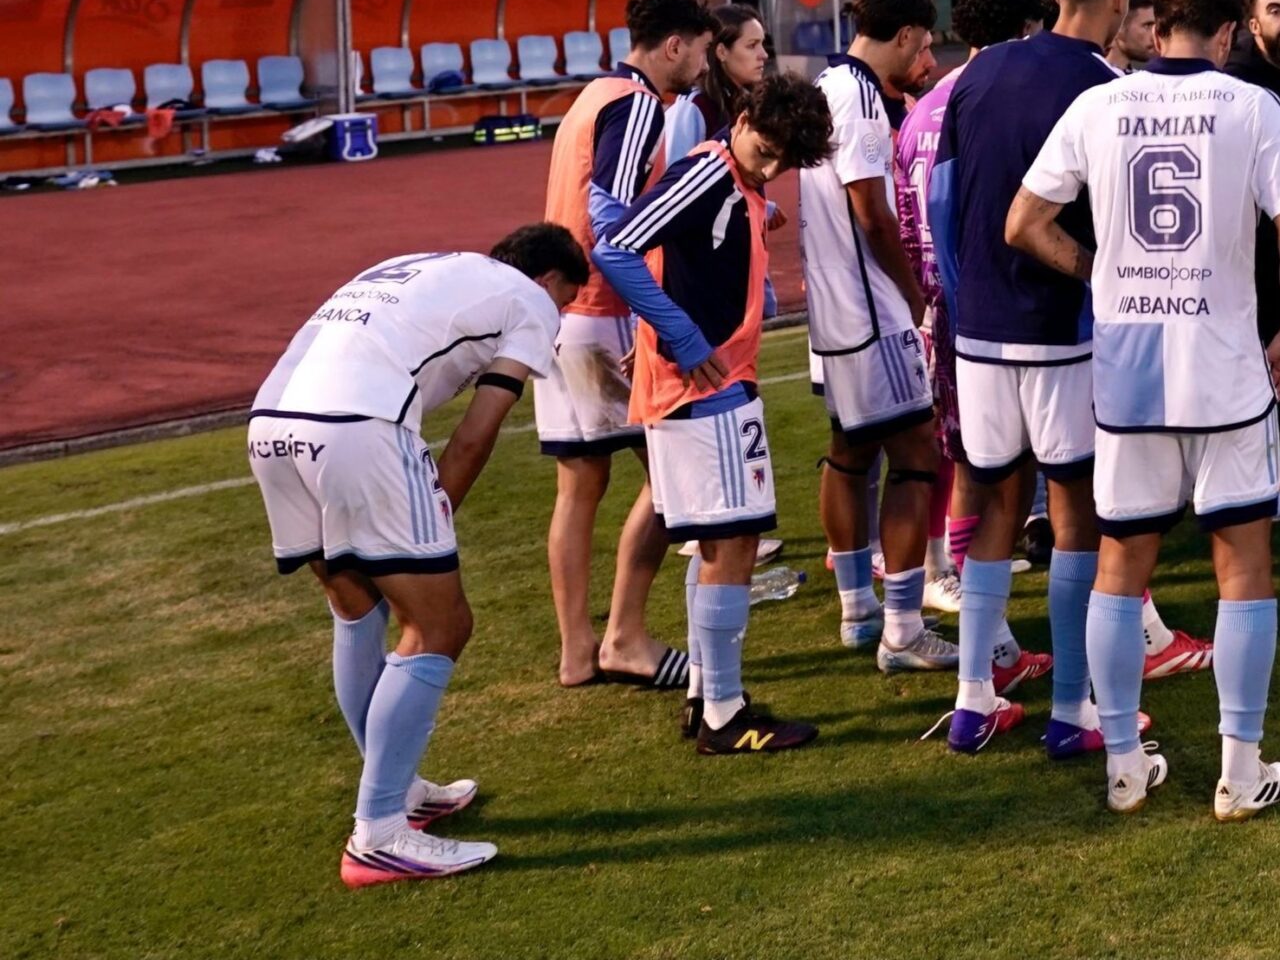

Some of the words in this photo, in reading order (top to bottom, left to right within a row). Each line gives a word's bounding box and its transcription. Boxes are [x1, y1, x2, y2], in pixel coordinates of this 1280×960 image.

[1107, 90, 1165, 105] JESSICA
[1172, 89, 1235, 103] FABEIRO
[1117, 114, 1217, 137] DAMIAN
[1127, 143, 1201, 253] 6
[1116, 265, 1213, 282] VIMBIOCORP
[900, 328, 922, 358] 4
[740, 417, 768, 464] 2
